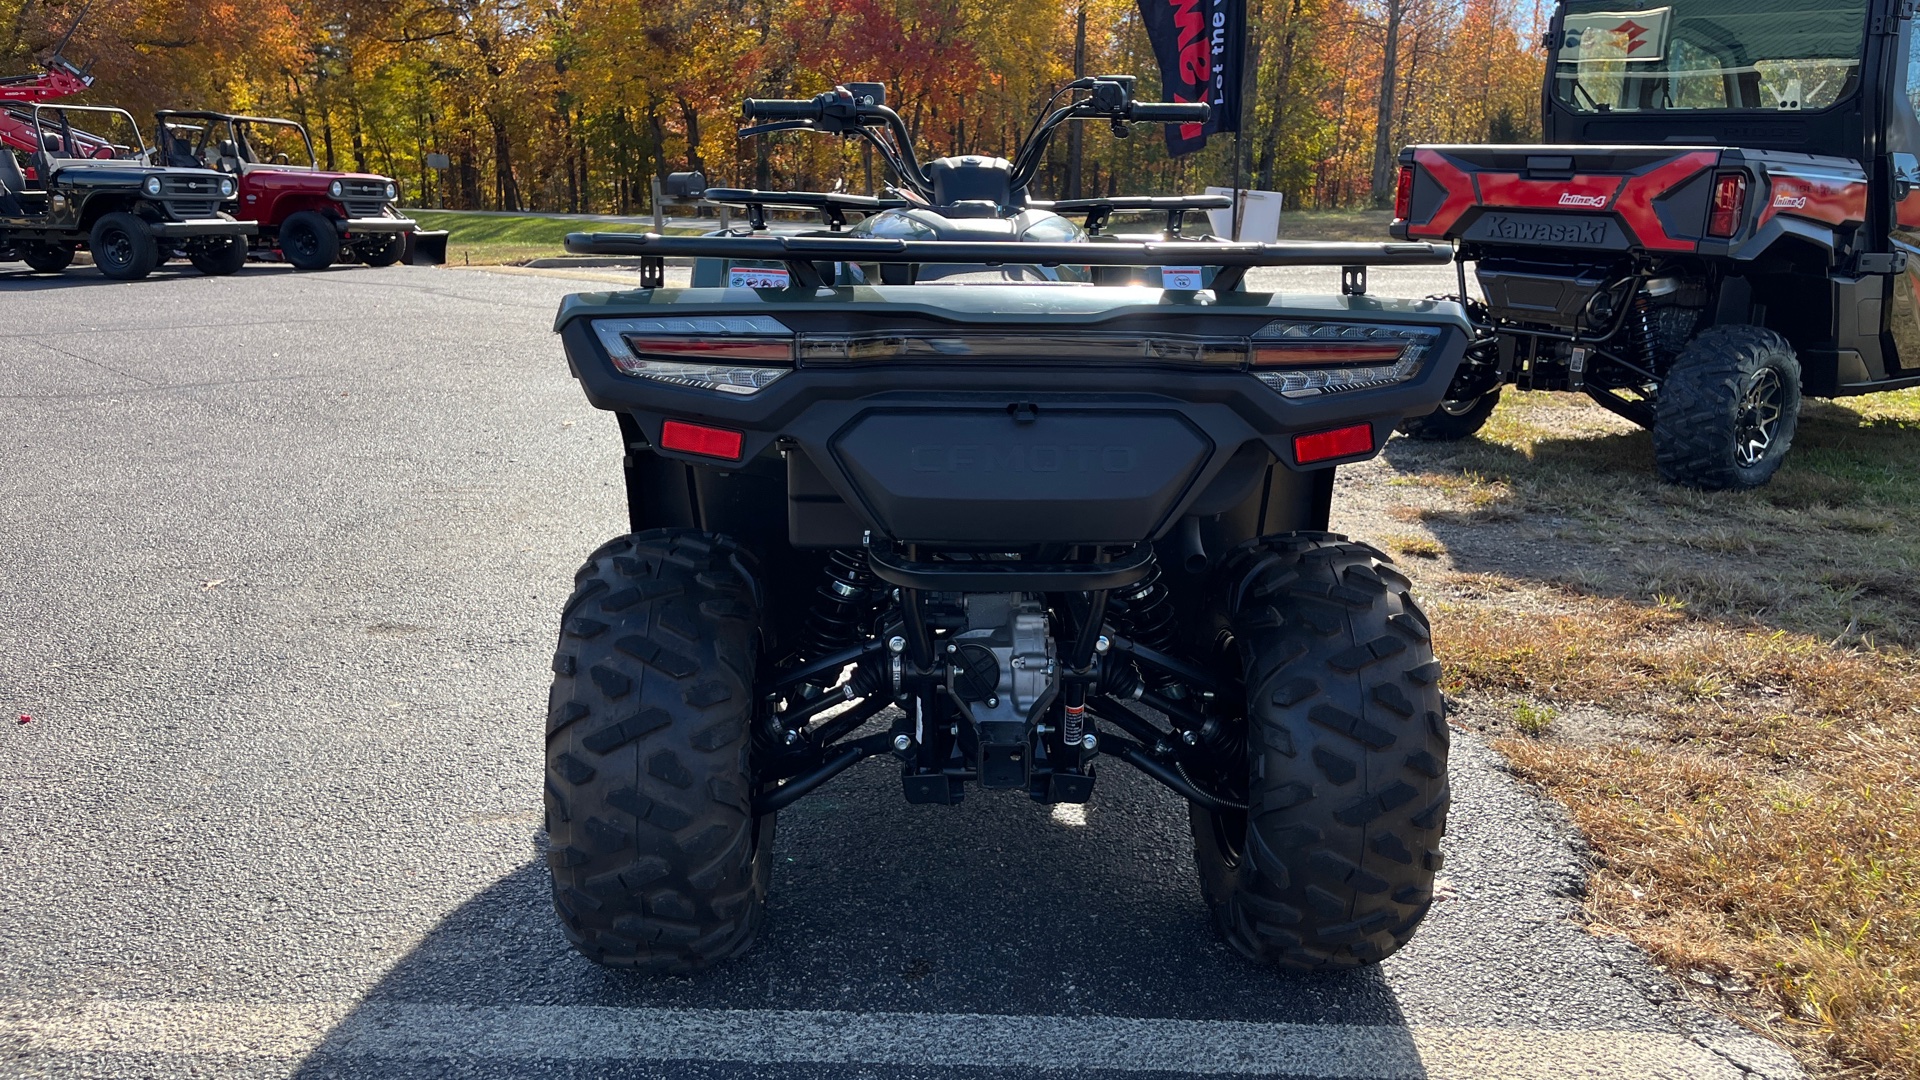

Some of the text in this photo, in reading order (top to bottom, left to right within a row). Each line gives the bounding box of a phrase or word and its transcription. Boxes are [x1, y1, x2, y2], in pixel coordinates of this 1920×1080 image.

[1211, 12, 1226, 56] the
[1722, 127, 1801, 137] RIDGE
[1559, 193, 1606, 207] Inline-4
[1773, 195, 1806, 208] Inline-4
[1487, 216, 1607, 244] Kawasaki
[911, 443, 1136, 473] CFMOTO
